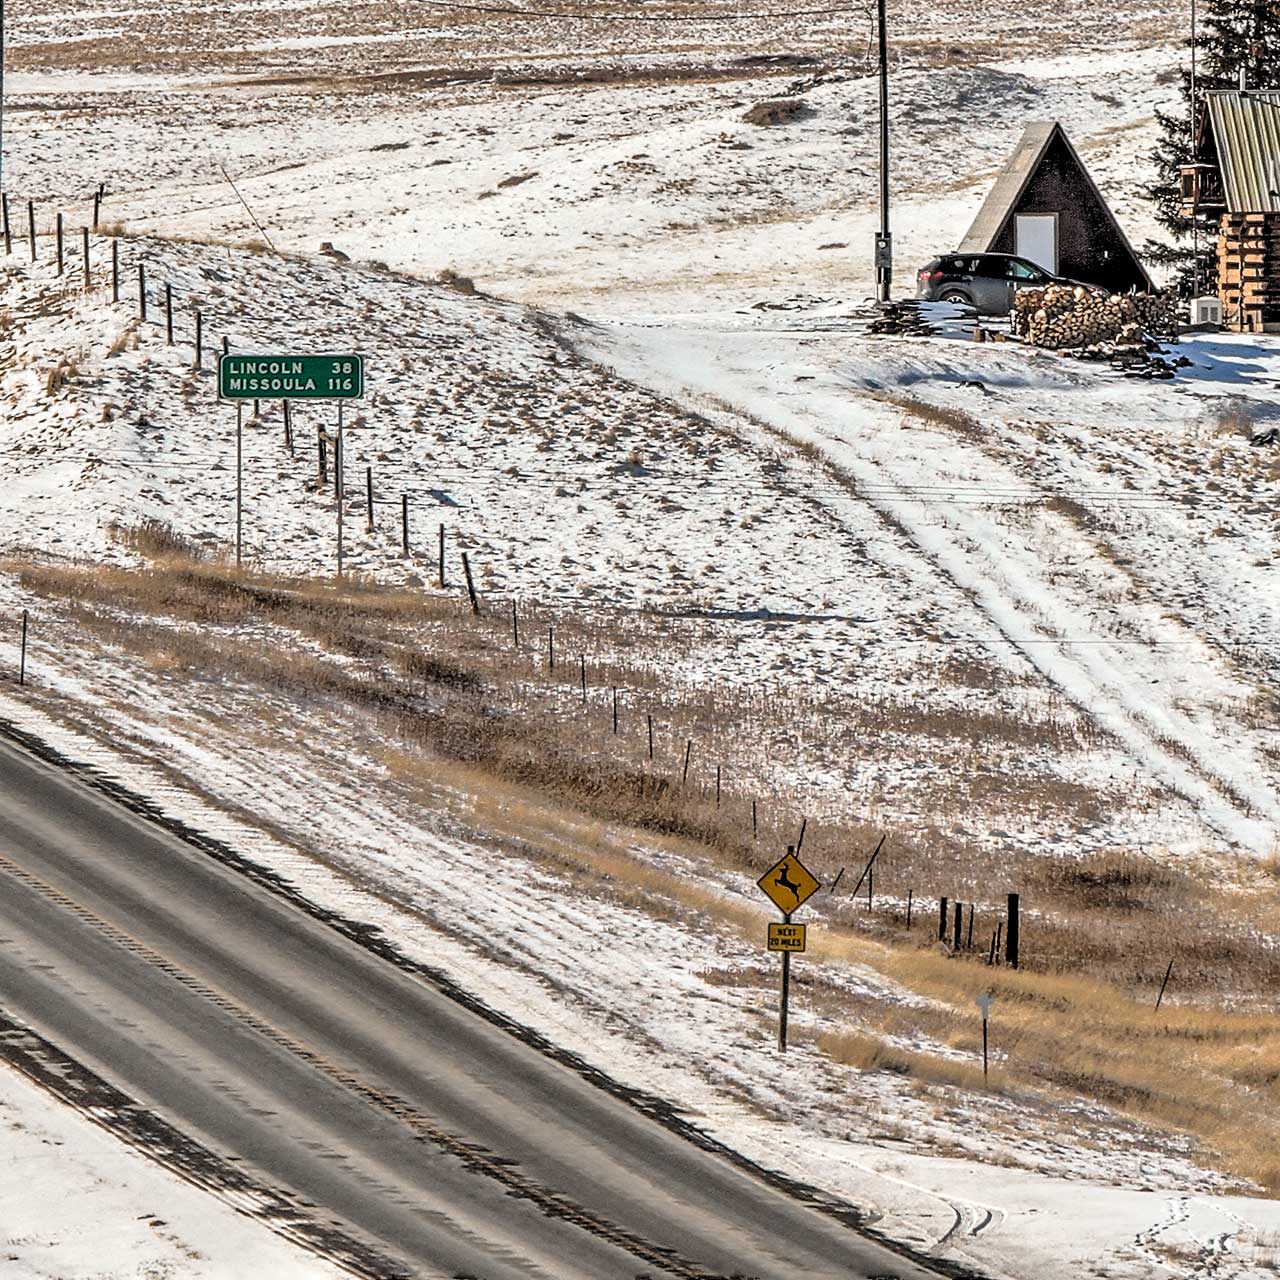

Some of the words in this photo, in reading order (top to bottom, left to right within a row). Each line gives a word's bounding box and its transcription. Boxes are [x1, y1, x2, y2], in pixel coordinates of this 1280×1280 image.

[229, 362, 302, 374] LINCOLN
[331, 362, 352, 374] 38
[229, 378, 316, 390] MISSOULA
[328, 378, 352, 390] 116
[777, 929, 796, 937] NEXT
[781, 938, 801, 946] MILES
